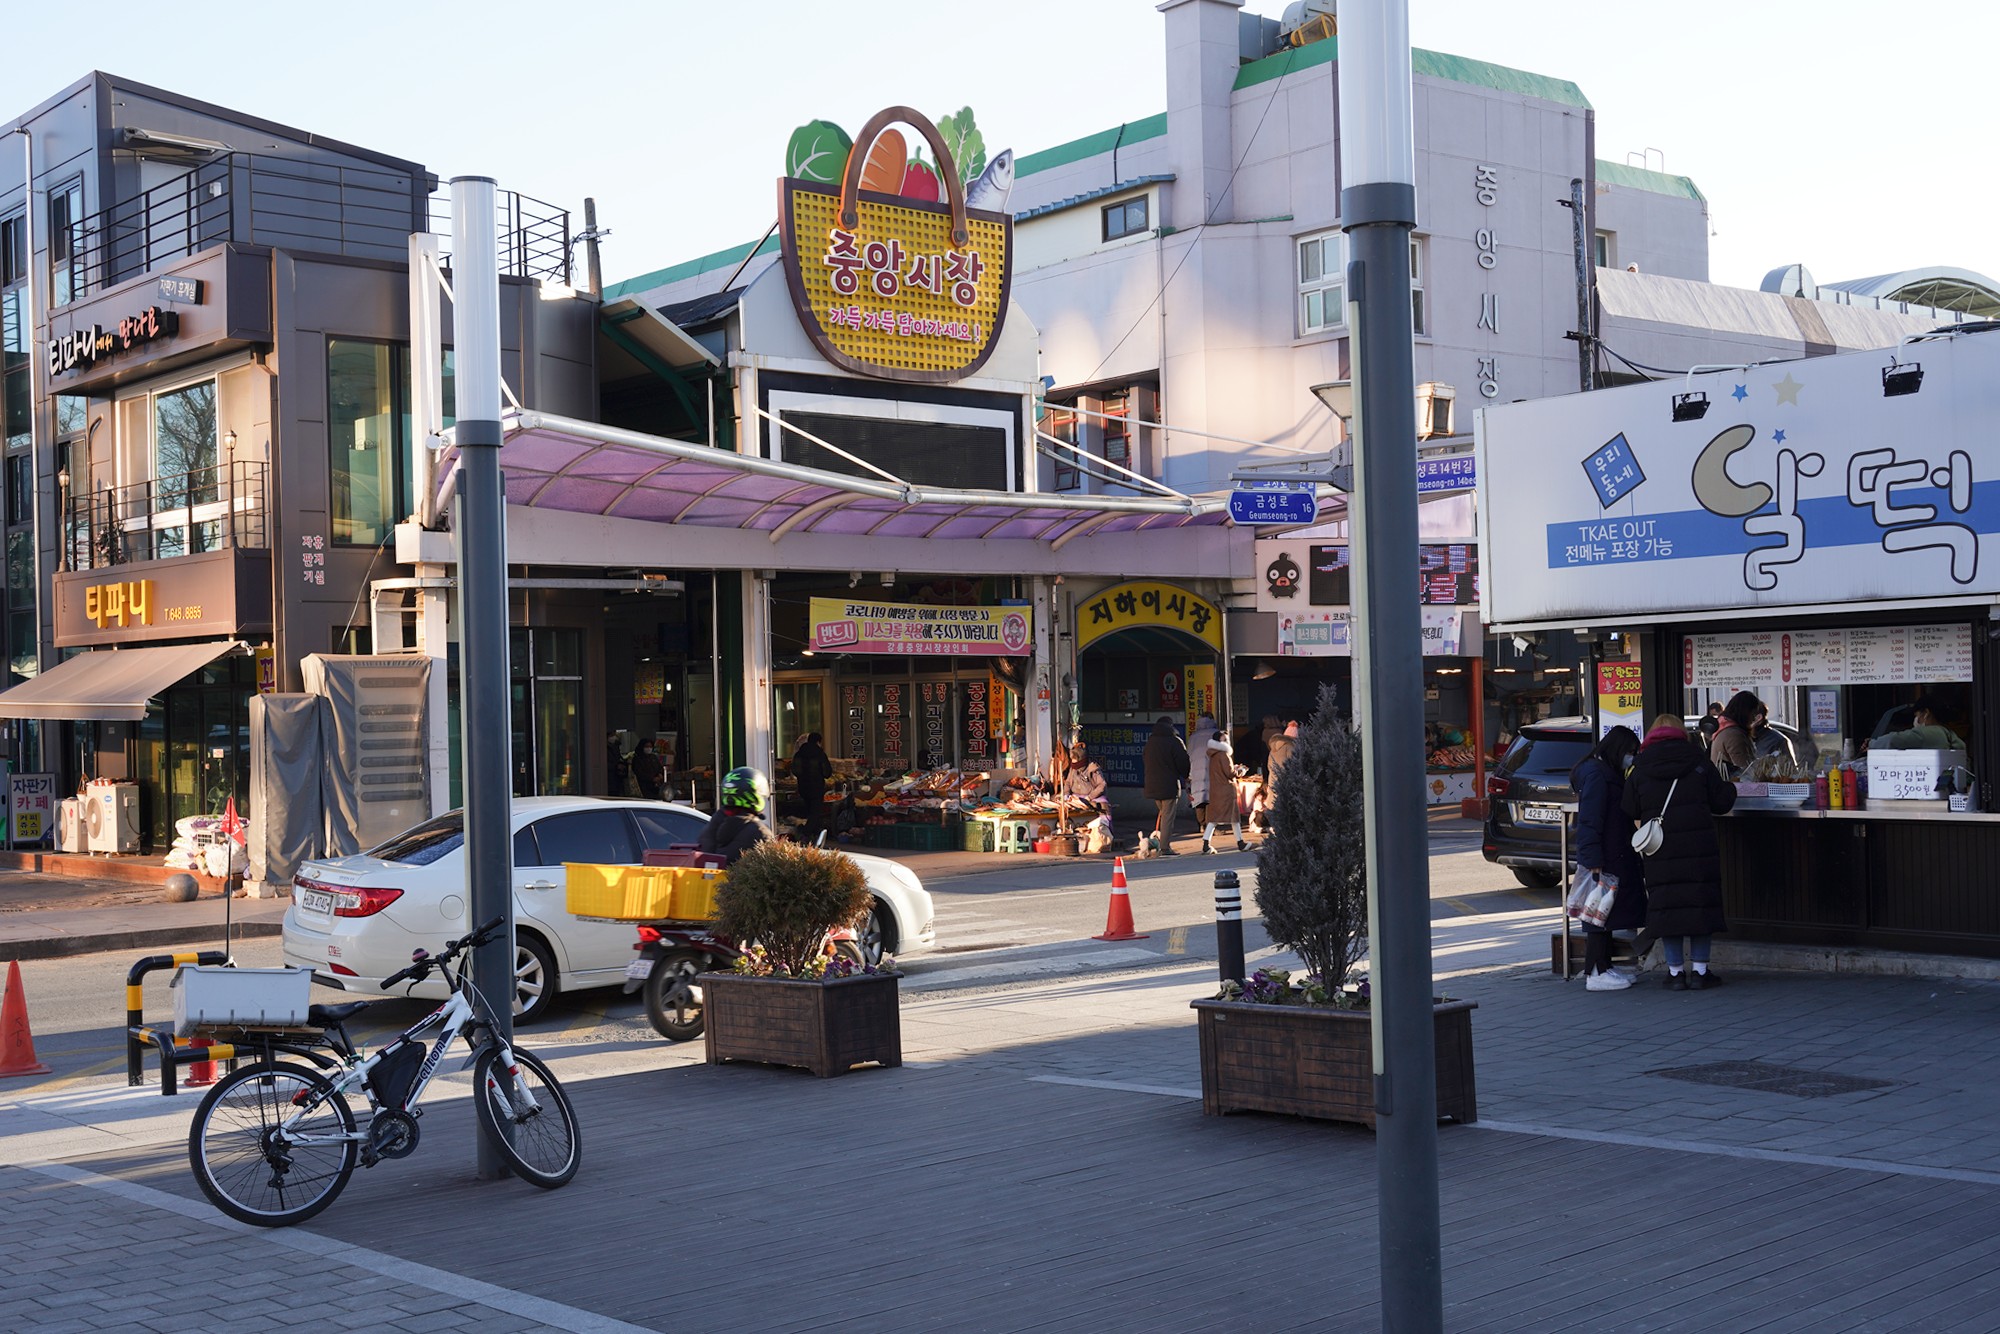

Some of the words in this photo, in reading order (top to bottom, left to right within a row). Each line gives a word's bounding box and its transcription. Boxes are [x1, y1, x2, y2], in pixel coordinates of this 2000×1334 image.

[823, 229, 984, 306] 중앙시장
[160, 279, 176, 296] 자판기
[177, 281, 196, 300] 휴게실
[1476, 165, 1500, 398] 중앙시장
[119, 305, 160, 349] 만나요
[830, 307, 861, 331] 가득
[865, 311, 895, 335] 가득
[1594, 445, 1622, 473] 우리
[1600, 464, 1635, 499] 동네
[1233, 501, 1243, 512] 12
[1256, 495, 1289, 509] 금성로
[1303, 503, 1312, 513] 16
[1249, 511, 1298, 522] Geumseong-ro
[1579, 524, 1619, 542] TKAE
[1623, 520, 1658, 539] OUT
[1565, 543, 1607, 563] 전메뉴
[1611, 540, 1640, 559] 포장
[1644, 537, 1673, 556] 가능
[86, 579, 149, 628] 티파니
[845, 604, 885, 618] 코로나19
[918, 609, 937, 621] 위해
[939, 610, 957, 622] 시장
[959, 611, 979, 622] 방문
[1090, 590, 1211, 633] 지하어시장
[1332, 612, 1350, 621] 코로
[820, 622, 854, 644] 반드시
[864, 621, 903, 640] 마스크를
[904, 623, 933, 641] 착용해
[933, 624, 961, 641] 주시기
[963, 624, 999, 641] 바랍니다
[887, 642, 970, 654] 강릉중앙시장상인회
[1615, 667, 1642, 679] 핫도그
[1615, 681, 1641, 692] 2,500
[884, 684, 902, 757] 공주청과
[968, 681, 988, 757] 공주청과
[926, 704, 944, 769] 과일일체
[14, 778, 53, 794] 자판기
[18, 795, 49, 810] 카페
[20, 814, 38, 822] 커피
[20, 830, 39, 838] 과자
